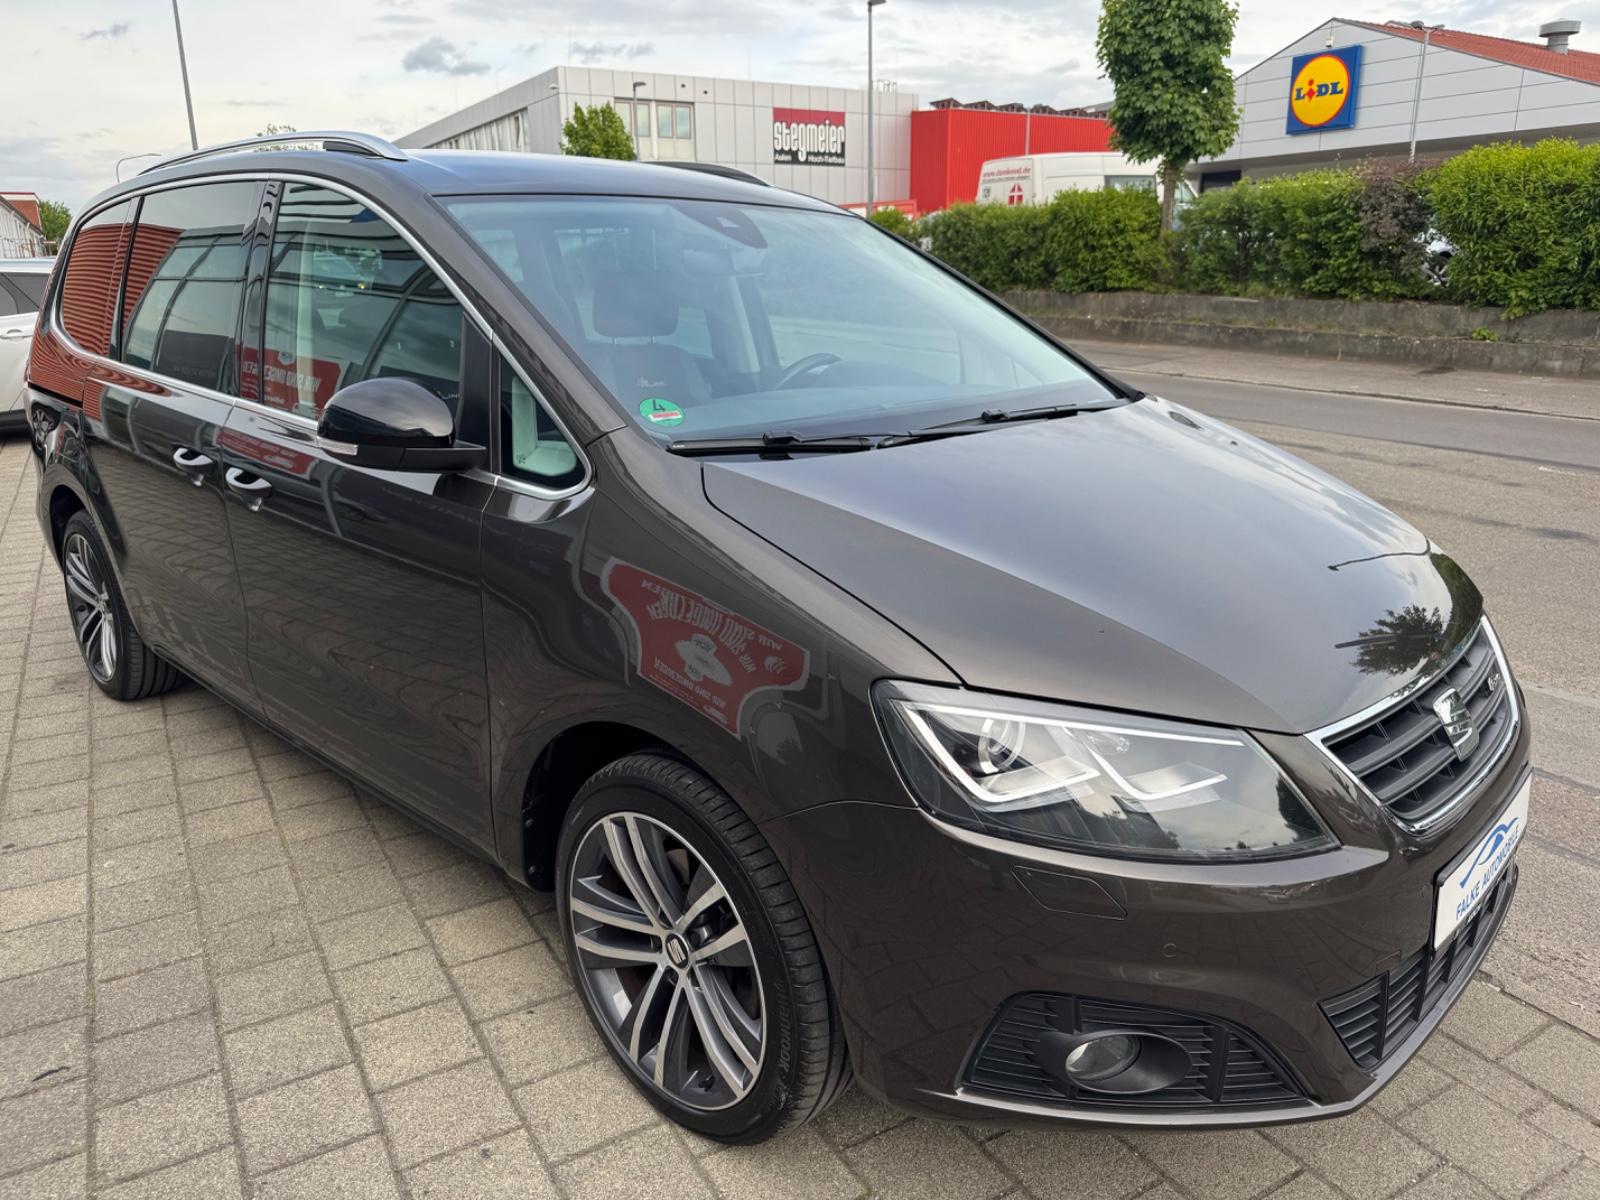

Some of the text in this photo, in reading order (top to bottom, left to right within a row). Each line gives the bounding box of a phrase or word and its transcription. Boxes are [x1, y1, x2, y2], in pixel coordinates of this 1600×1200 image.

[773, 119, 845, 162] stegmeier
[652, 399, 666, 412] 4
[1456, 880, 1481, 921] FALKE
